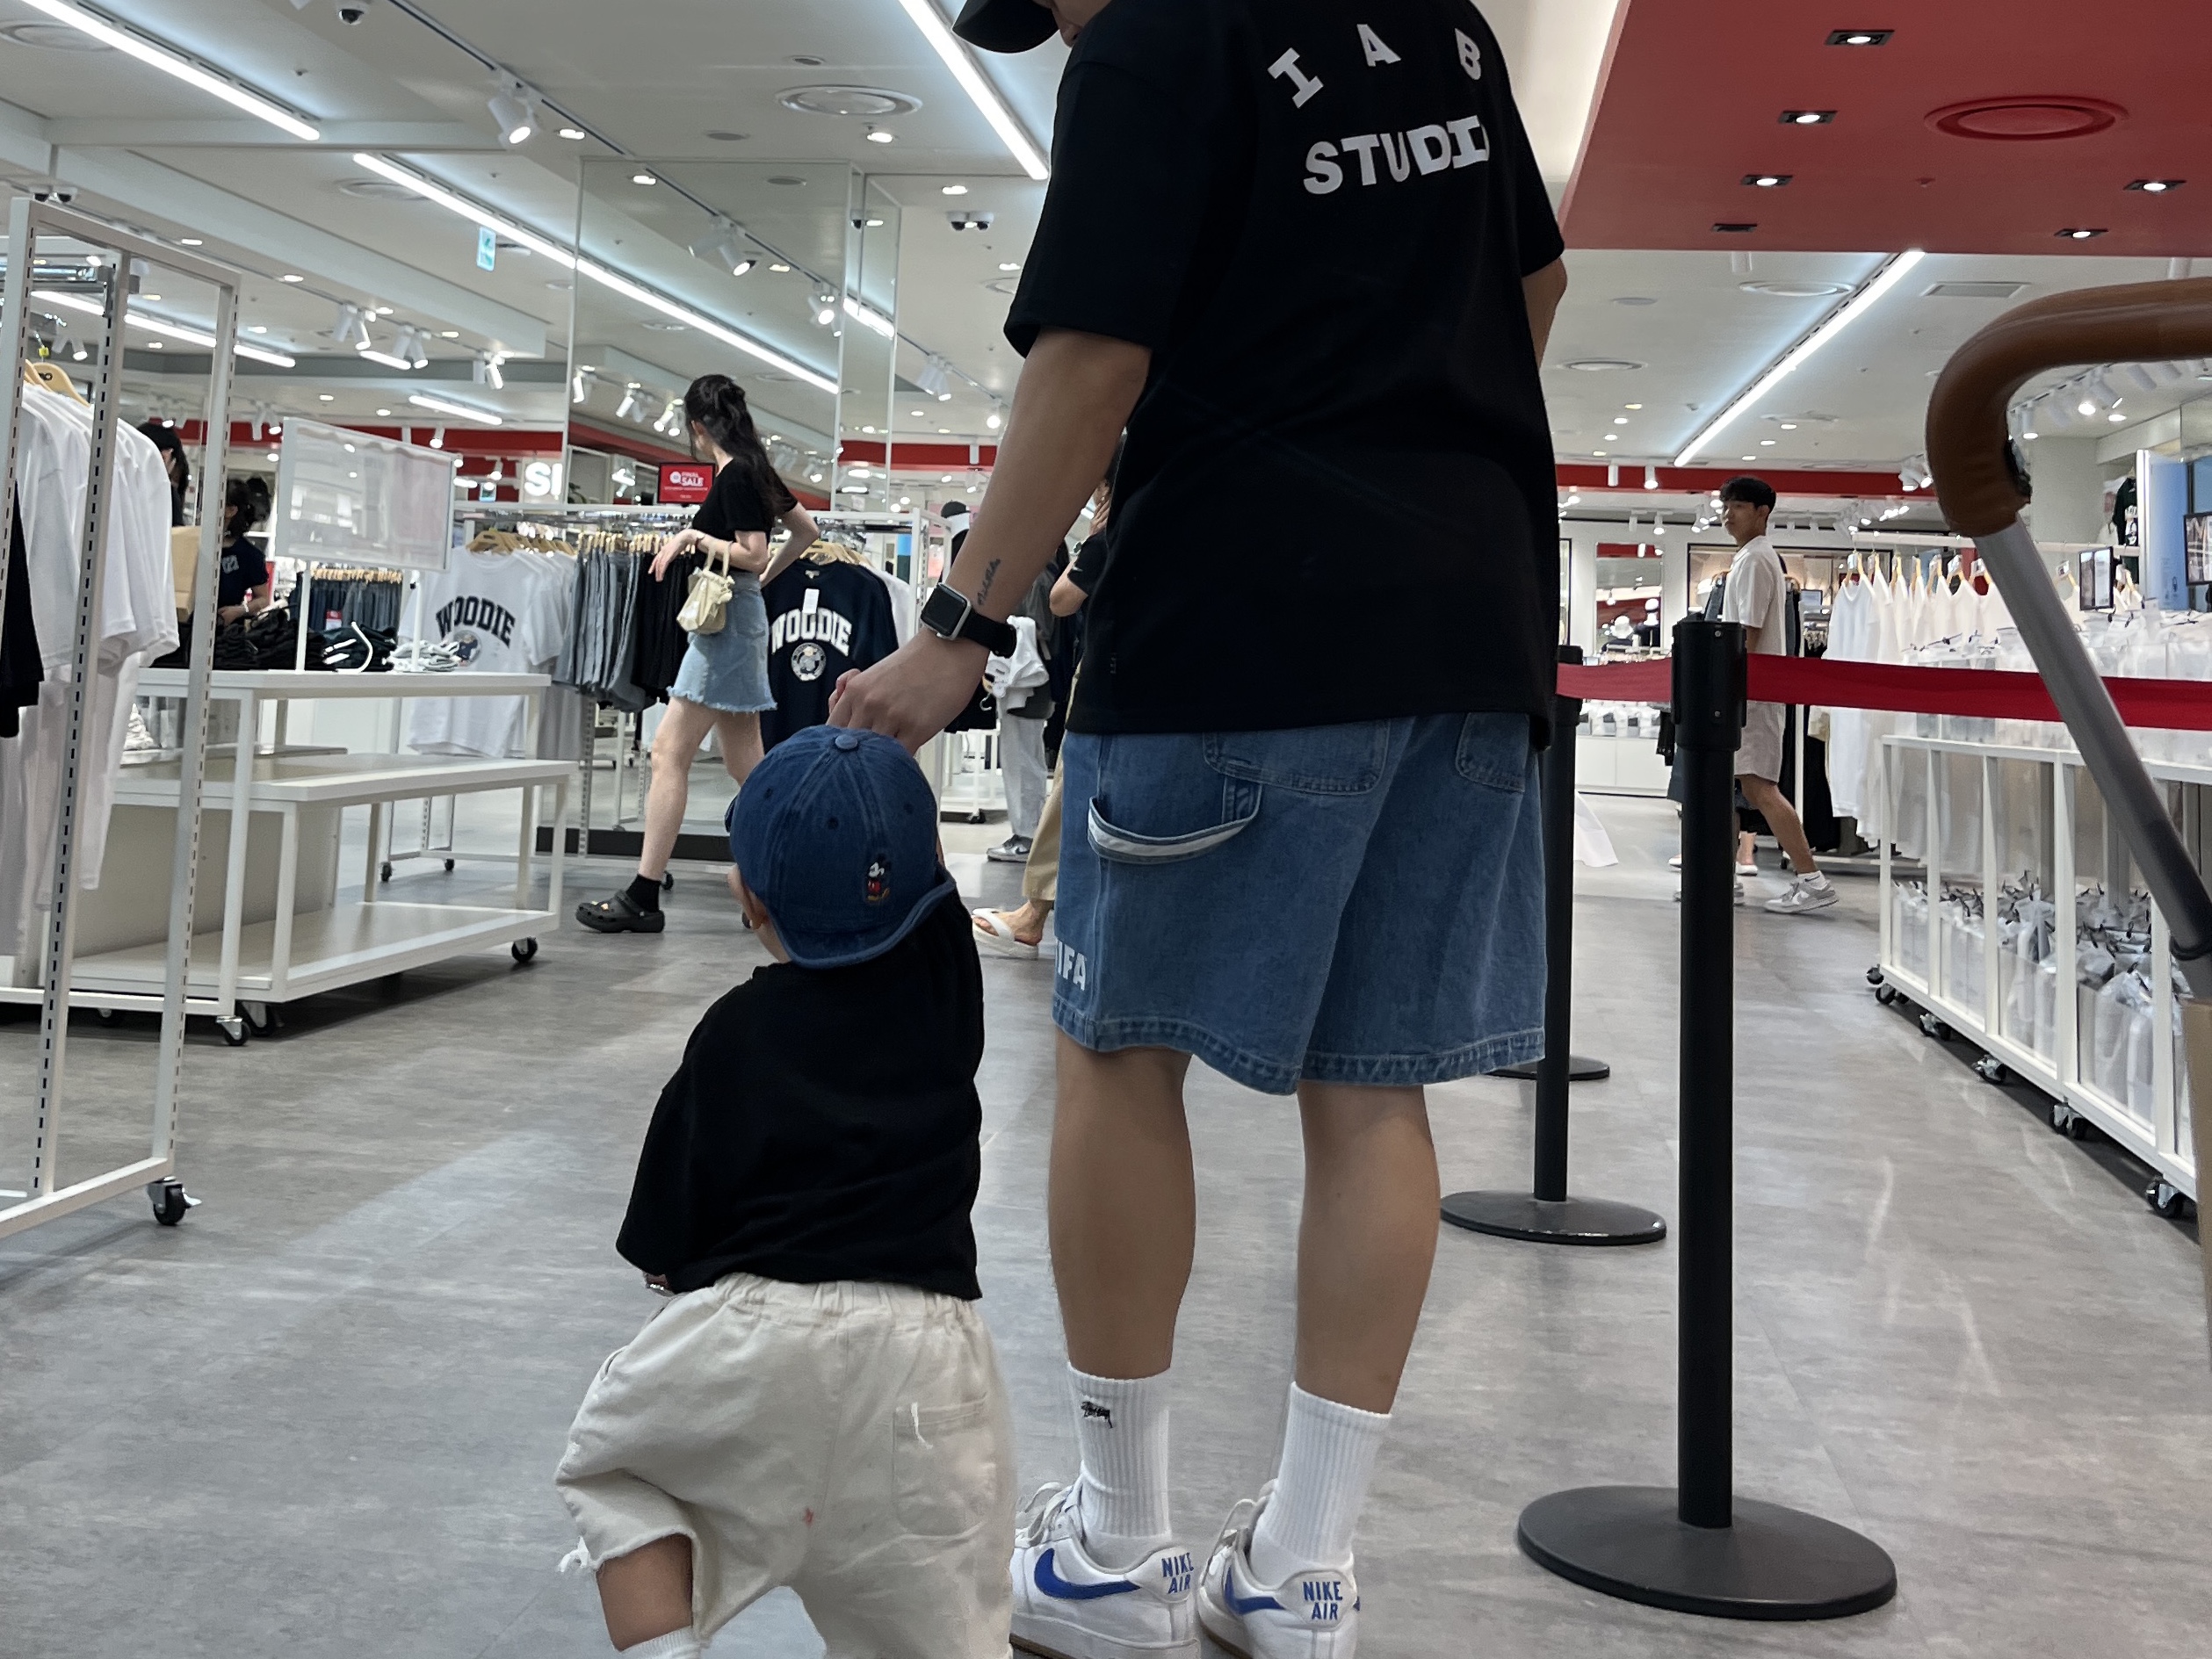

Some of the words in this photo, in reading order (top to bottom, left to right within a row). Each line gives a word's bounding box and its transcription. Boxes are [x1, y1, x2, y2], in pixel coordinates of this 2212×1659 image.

[1268, 47, 1324, 109] I
[1356, 24, 1401, 67] A
[1455, 28, 1481, 80] B
[1304, 115, 1490, 195] STUDI
[1161, 1553, 1194, 1577] NIKE
[1168, 1574, 1190, 1594] AIR
[1303, 1581, 1342, 1601] NIKE
[1312, 1602, 1338, 1620] AIR
